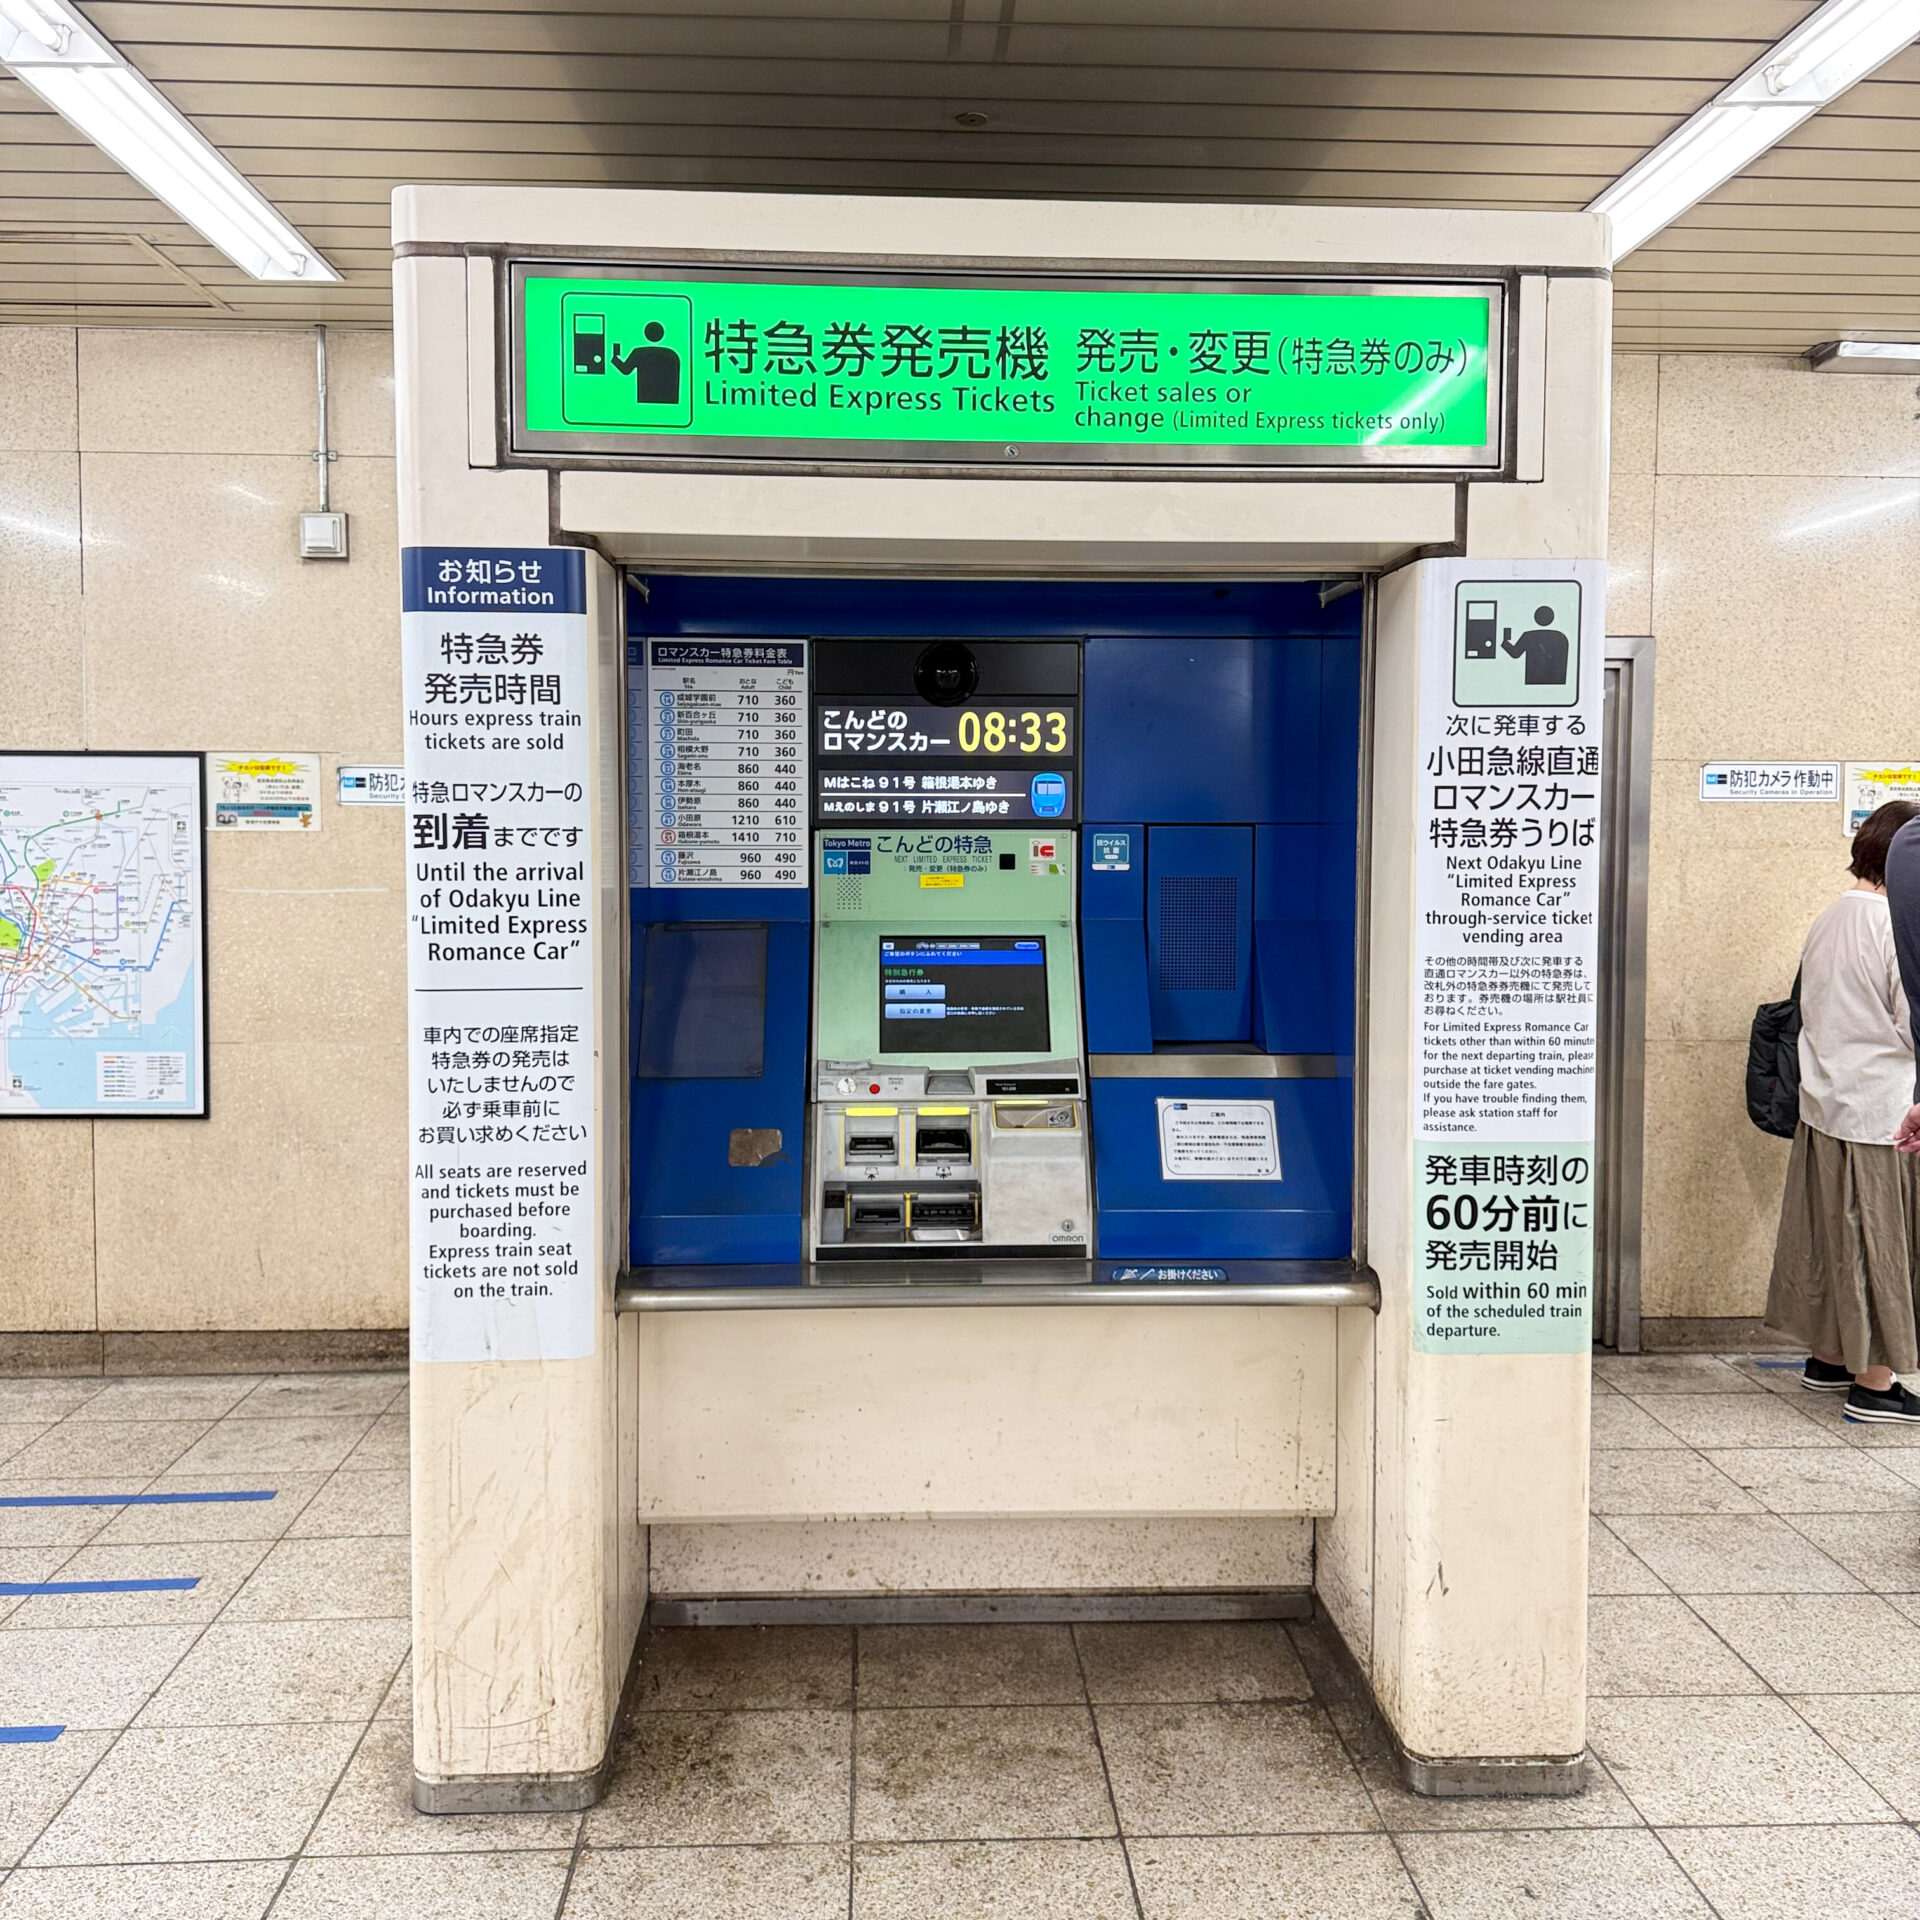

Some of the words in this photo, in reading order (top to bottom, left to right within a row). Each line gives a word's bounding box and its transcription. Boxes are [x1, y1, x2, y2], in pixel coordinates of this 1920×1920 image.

[704, 317, 1051, 381] 特急券発売機
[706, 380, 816, 410] Limited
[830, 382, 944, 415] Express
[954, 381, 1055, 413] Tickets
[1075, 380, 1147, 404] Ticket
[1156, 380, 1216, 406] sales
[1224, 387, 1251, 406] or
[1075, 406, 1164, 432] change
[1173, 409, 1249, 433] (Limited
[1255, 409, 1324, 433] Express
[1331, 411, 1392, 433] tickets
[1400, 411, 1445, 433] only)
[439, 559, 542, 584] お知らせ
[428, 586, 553, 605] Information
[441, 632, 543, 665] 特急券
[658, 647, 787, 659] ロマンスカー特急券料金表
[425, 673, 561, 704] 発売時間
[738, 695, 759, 705] 710
[775, 695, 795, 705] 360
[410, 710, 458, 726] Hours
[465, 712, 532, 730] express
[540, 710, 581, 726] train
[738, 713, 759, 722] 710
[775, 713, 795, 723] 360
[824, 709, 907, 730] こんどの
[1445, 714, 1586, 736] 次に発車する
[738, 730, 759, 740] 710
[775, 730, 795, 740] 360
[959, 711, 1066, 752] 08:33
[824, 732, 950, 752] ロマンスカー
[738, 764, 759, 774] 860
[775, 764, 795, 774] 440
[1427, 745, 1598, 776] 小田急線直通
[922, 776, 998, 790] 箱根湯本ゆき
[1730, 770, 1833, 788] 防犯カメラ作動中
[413, 781, 582, 803] 特急ロマンスカーの
[1434, 782, 1595, 810] ロマンスカー
[922, 801, 1010, 814] 片瀬江ノ島ゆき
[732, 815, 759, 825] 1210
[775, 815, 796, 825] 610
[413, 813, 583, 850] 到着までです
[732, 832, 759, 842] 1410
[776, 832, 796, 842] 710
[1429, 817, 1596, 848] 特急券うりば
[824, 839, 846, 848] Tokyo
[877, 835, 992, 853] こんどの特急
[740, 853, 761, 863] 960
[775, 853, 796, 863] 490
[894, 855, 908, 863] NEXT
[913, 855, 937, 863] LIMITED
[943, 855, 967, 863] EXPRESS
[972, 855, 992, 863] TICKET
[1446, 856, 1482, 870] Next
[1487, 855, 1545, 873] Odakyu
[1551, 855, 1582, 870] Line
[416, 862, 465, 882] Until
[474, 862, 507, 882] the
[516, 861, 583, 881] arrival
[740, 870, 761, 880] 960
[775, 870, 796, 880] 490
[1519, 875, 1576, 891] Express
[421, 889, 441, 908] of
[450, 888, 529, 912] Odakyu
[538, 888, 580, 908] Line
[1461, 893, 1531, 906] Romance
[509, 916, 586, 938] Express
[1426, 910, 1546, 928] through-service
[1552, 910, 1592, 925] ticket
[1463, 929, 1523, 946] vending
[1529, 932, 1562, 943] area
[428, 943, 525, 961] Romance
[1425, 956, 1583, 967] その他の時間帯及び次に発車する
[1424, 968, 1588, 979] 直通ロマンスカー以外の特急券は、
[1424, 981, 1591, 991] 改札外の特急券券売機にて発売して
[1424, 993, 1593, 1004] おります。券売機の場所は駅社員に
[1424, 1006, 1503, 1016] お尋ねください。
[423, 1025, 579, 1044] 車内での座席指定
[1424, 1022, 1440, 1032] For
[1443, 1022, 1480, 1032] Limited
[1484, 1022, 1522, 1034] Express
[1525, 1022, 1571, 1032] Romance
[1574, 1022, 1589, 1032] Car
[432, 1050, 569, 1069] 特急券の発売は
[1424, 1050, 1439, 1060] for
[1442, 1050, 1458, 1060] the
[1461, 1051, 1483, 1060] next
[1486, 1050, 1535, 1062] departing
[1539, 1050, 1565, 1061] train,
[428, 1076, 575, 1093] いたしませんので
[1423, 1079, 1461, 1089] outside
[1464, 1079, 1480, 1089] the
[1484, 1079, 1503, 1089] fare
[1507, 1080, 1536, 1091] gates.
[442, 1100, 560, 1118] 必ず乗車前に
[419, 1125, 587, 1143] お買い求めください
[1423, 1123, 1477, 1132] assistance.
[415, 1164, 433, 1179] All
[439, 1164, 480, 1179] seats
[487, 1165, 512, 1178] are
[518, 1161, 586, 1177] reserved
[1426, 1155, 1588, 1186] 発車時刻の
[430, 1204, 512, 1222] purchased
[518, 1202, 570, 1217] before
[1426, 1195, 1588, 1232] 60分前に
[460, 1223, 536, 1240] boarding.
[1426, 1239, 1558, 1271] 発売開始
[1158, 1268, 1218, 1281] お掛けください
[1427, 1285, 1458, 1299] Sold
[1463, 1282, 1520, 1299] within
[1527, 1282, 1549, 1299] 60
[1556, 1282, 1587, 1299] min
[1427, 1323, 1500, 1340] departure.
